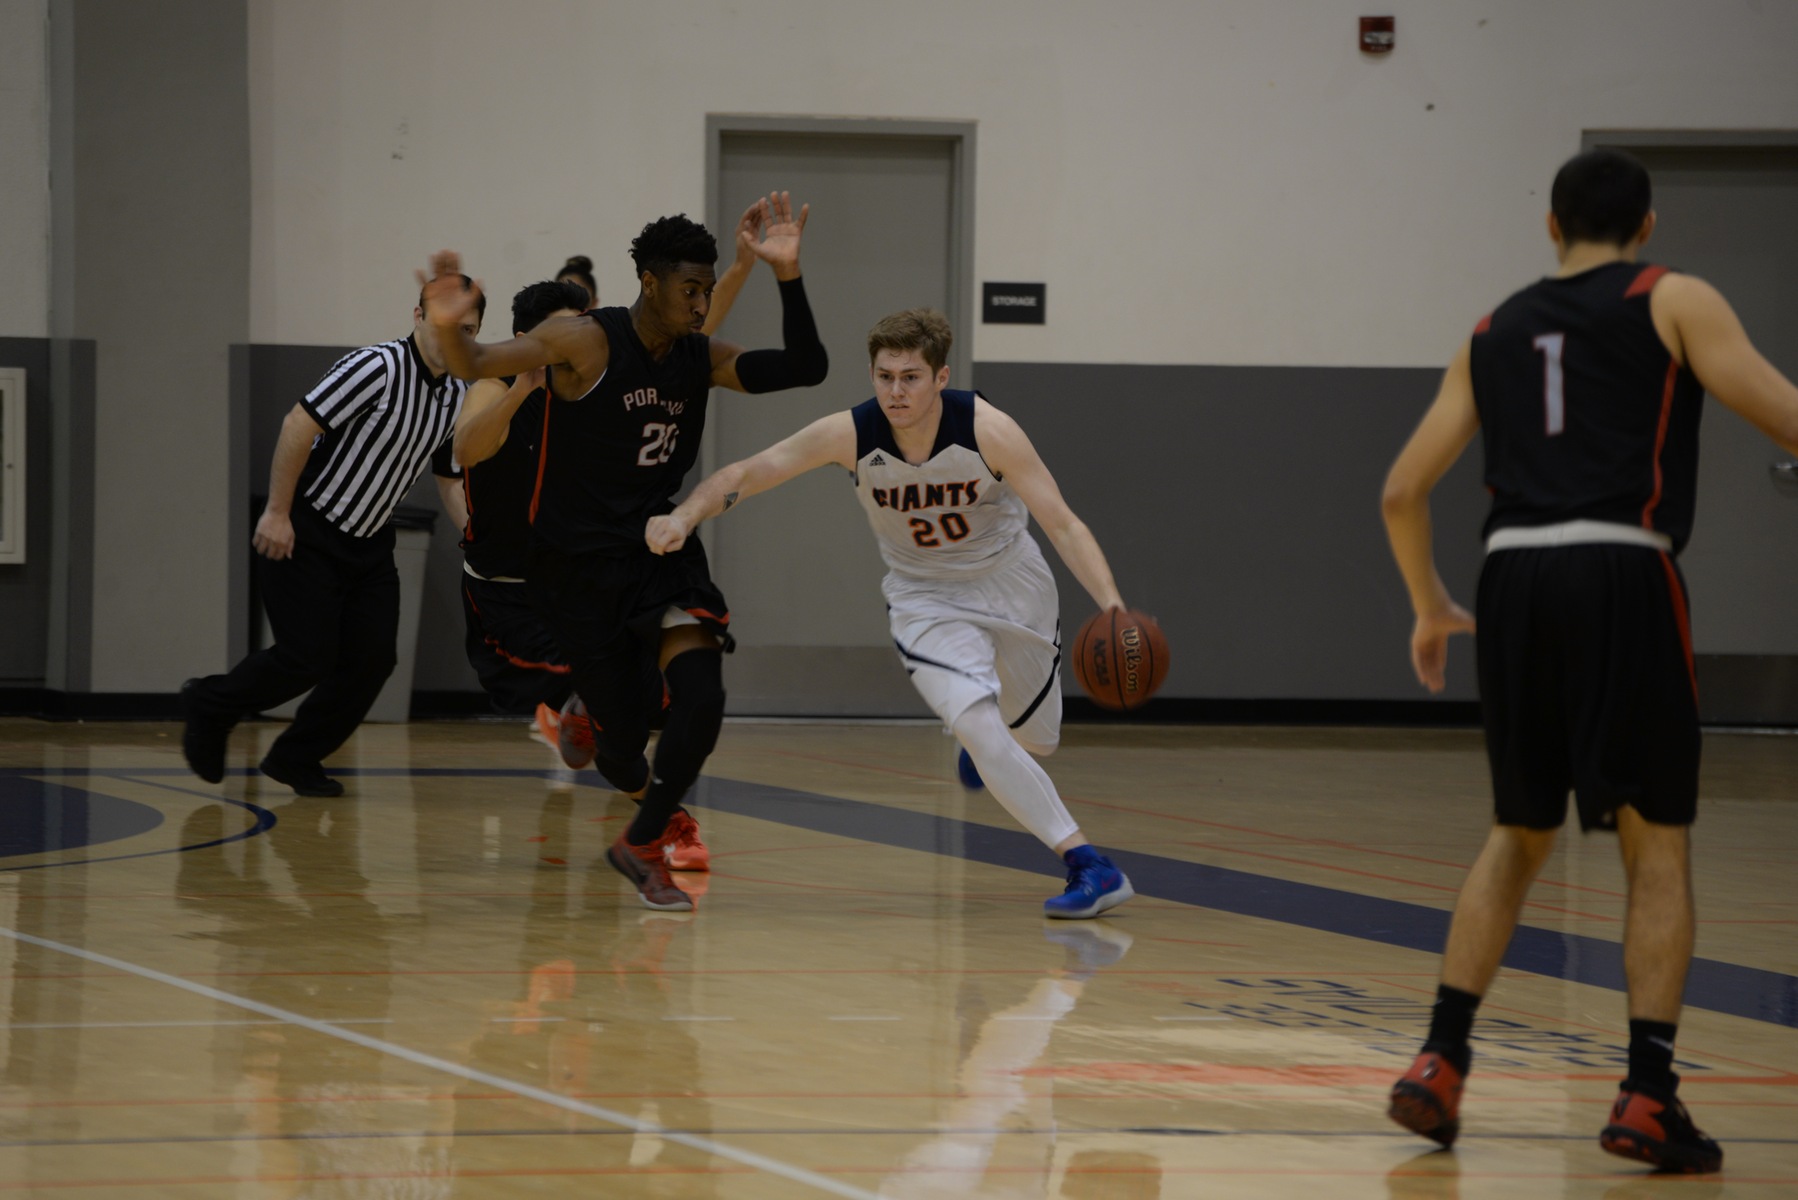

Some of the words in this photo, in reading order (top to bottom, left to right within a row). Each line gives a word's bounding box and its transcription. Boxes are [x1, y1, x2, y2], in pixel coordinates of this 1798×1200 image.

[992, 295, 1037, 306] STORAGE
[1532, 333, 1565, 436] 1
[872, 478, 981, 512] GIANTS
[908, 512, 970, 547] 20
[1121, 626, 1142, 693] Wilson
